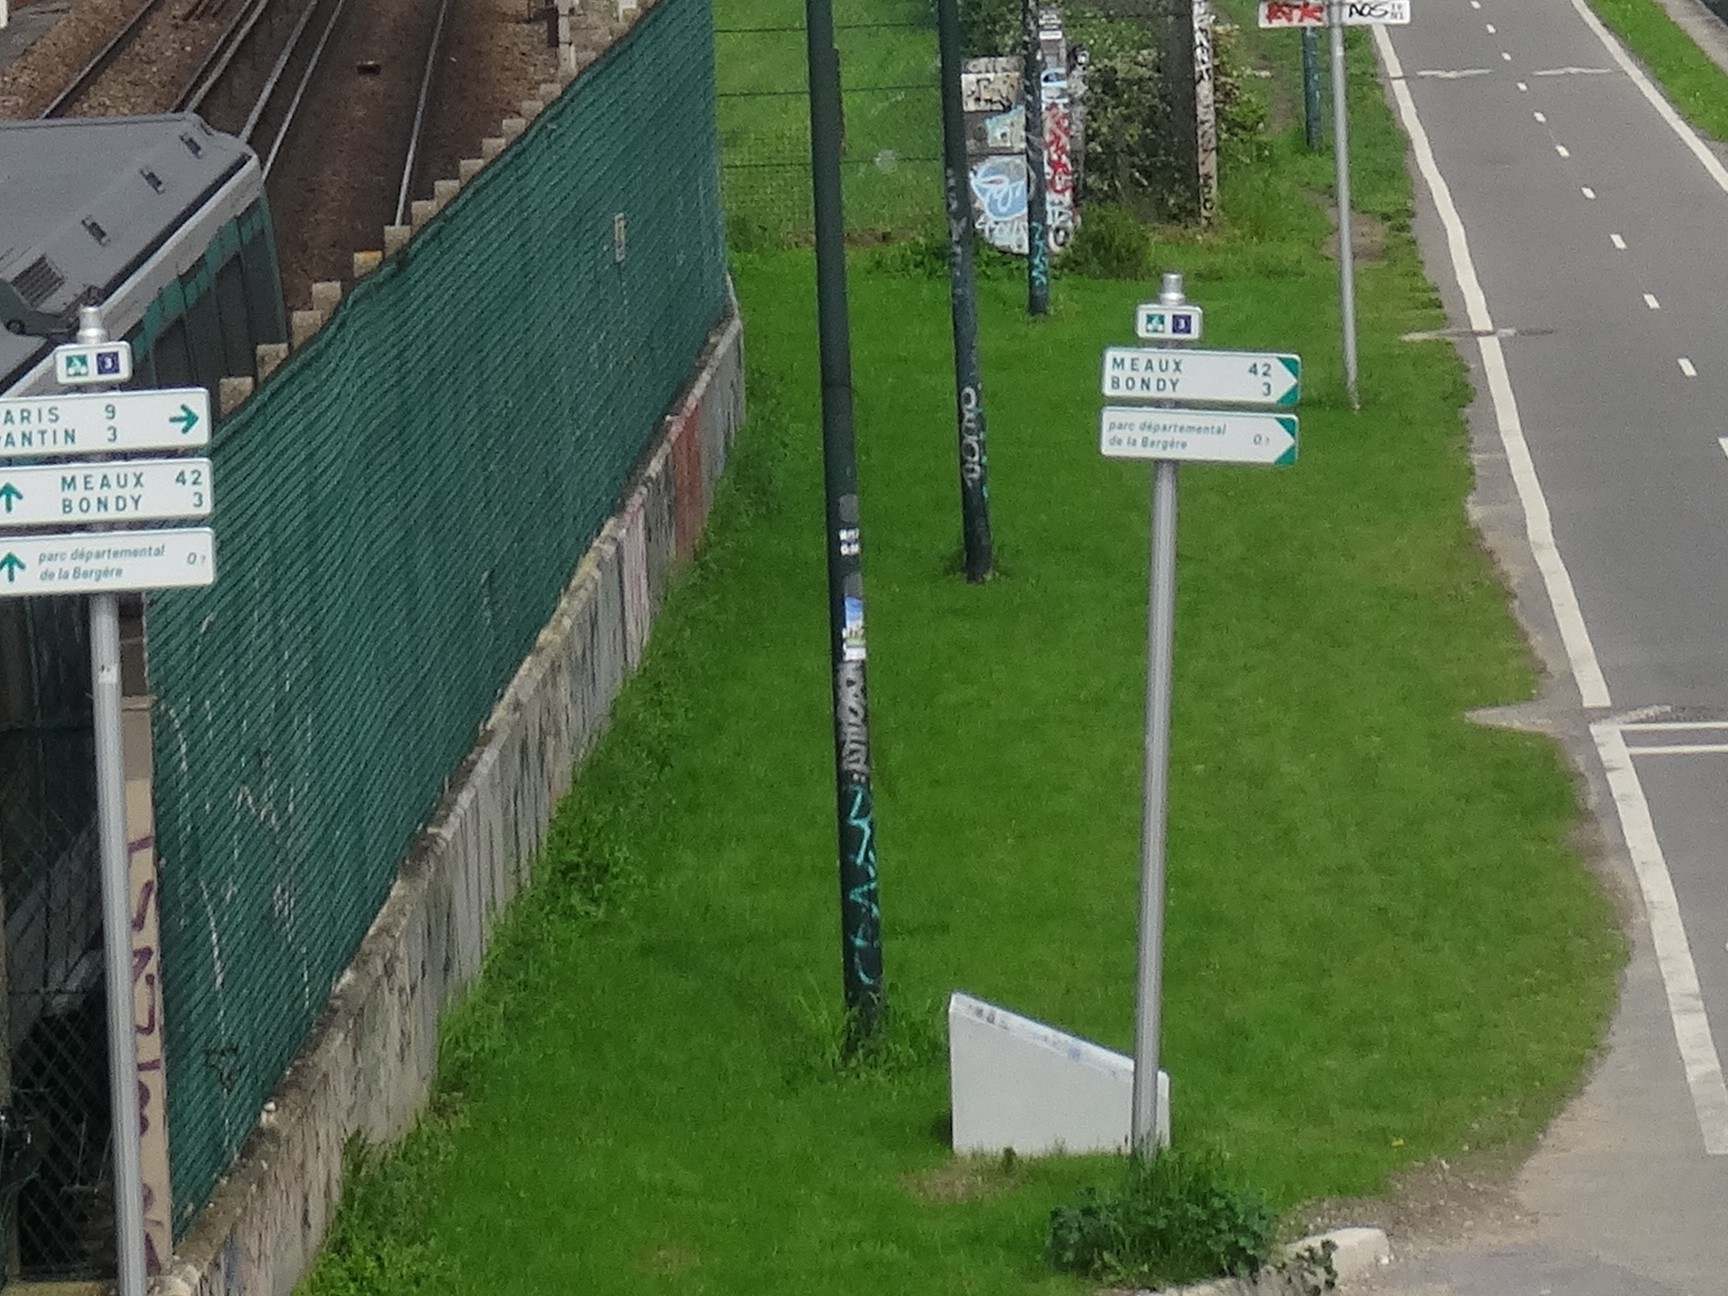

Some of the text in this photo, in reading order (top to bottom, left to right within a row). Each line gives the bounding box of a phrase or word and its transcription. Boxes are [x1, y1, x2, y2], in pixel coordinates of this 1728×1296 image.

[1111, 356, 1272, 377] MEAUX 42
[1111, 375, 1272, 397] BONDY 3
[104, 403, 116, 421] 9
[106, 425, 118, 443] 3
[1108, 421, 1227, 435] parc départemental
[1108, 435, 1123, 447] de
[1126, 436, 1138, 447] la
[61, 469, 203, 492] MEAUX 42
[61, 491, 204, 515] BONDY 3
[38, 544, 166, 566] parc départemental
[39, 568, 56, 582] de
[57, 567, 70, 581] la
